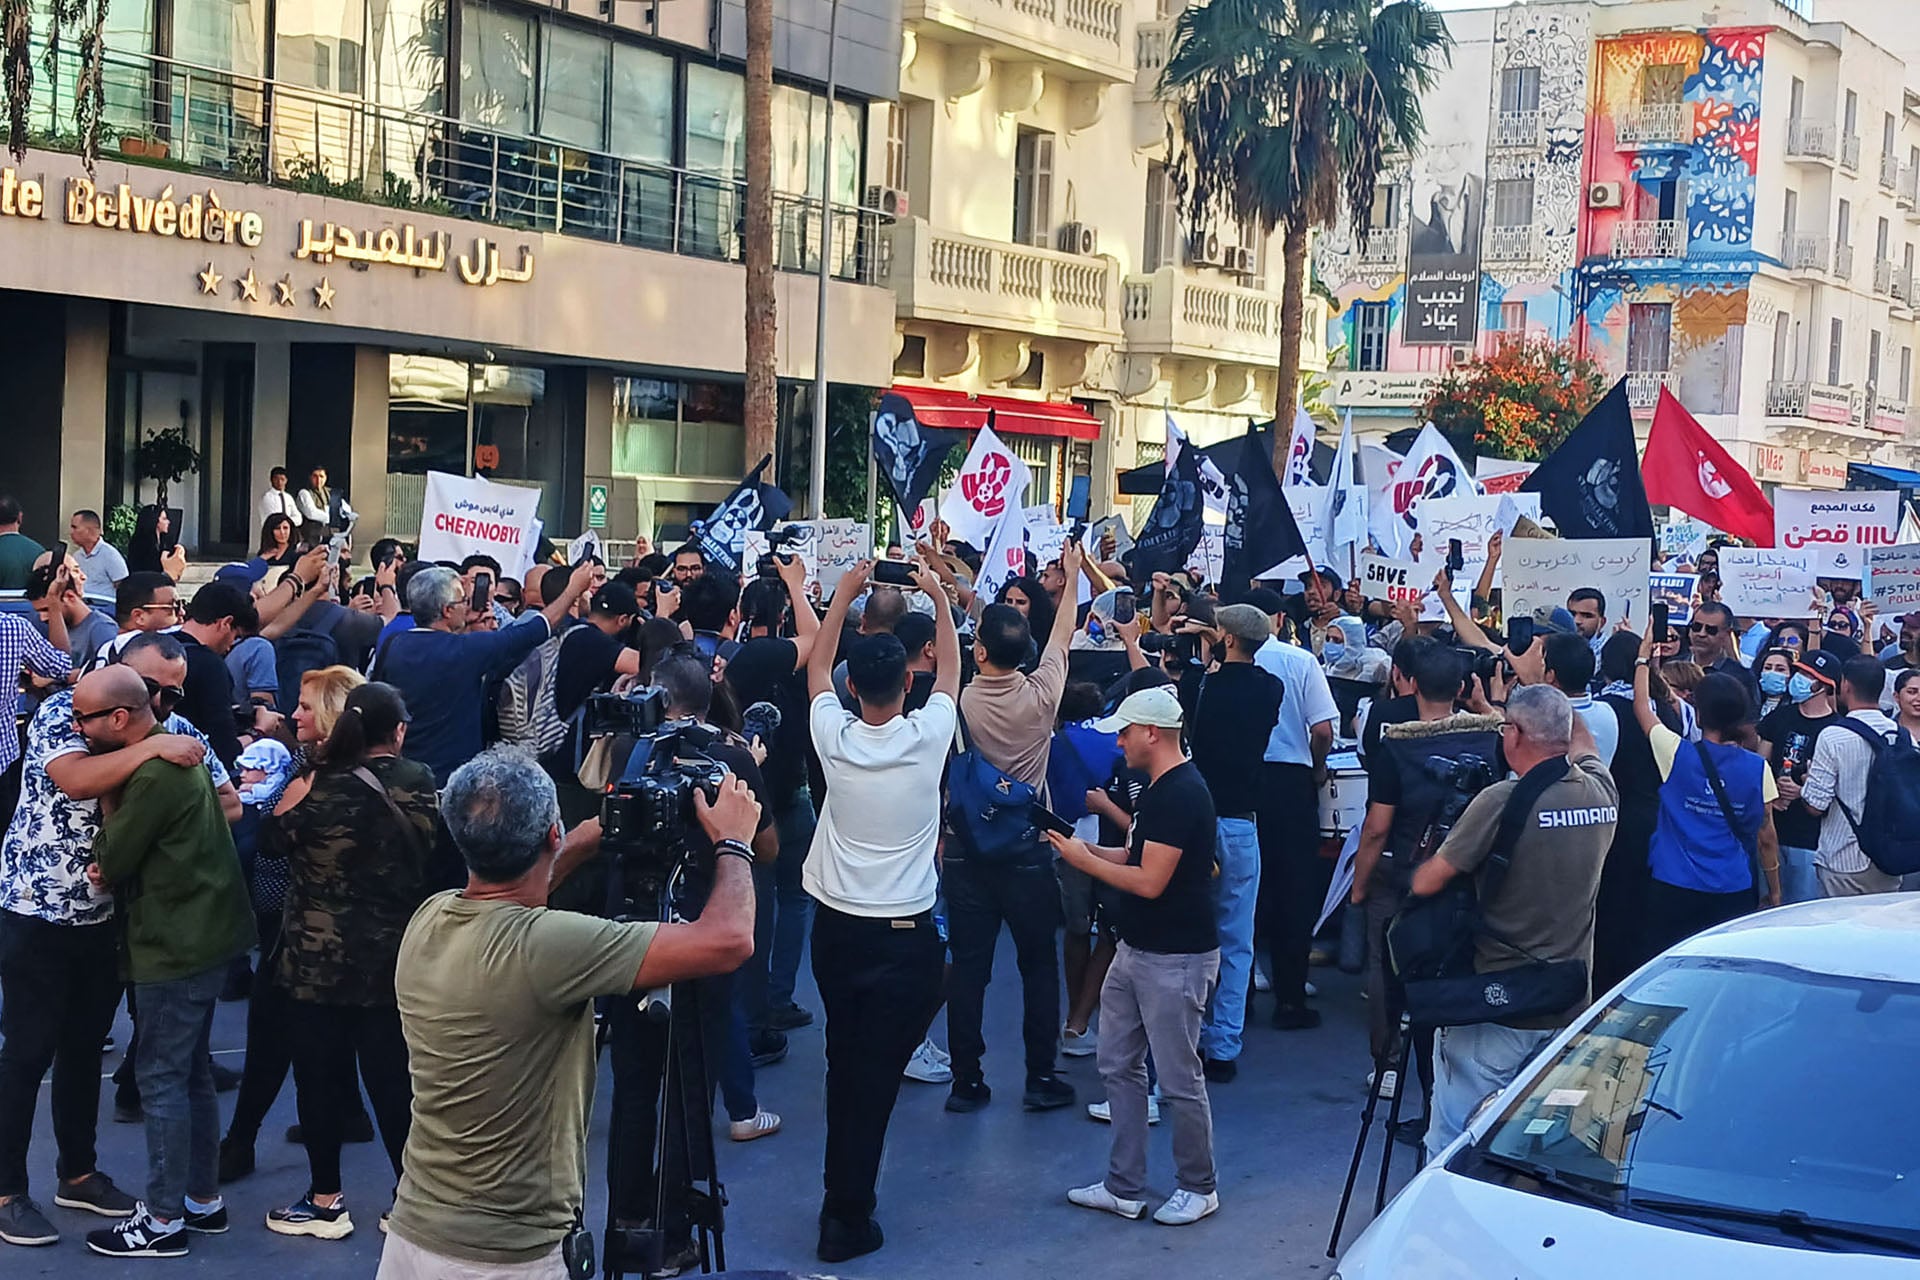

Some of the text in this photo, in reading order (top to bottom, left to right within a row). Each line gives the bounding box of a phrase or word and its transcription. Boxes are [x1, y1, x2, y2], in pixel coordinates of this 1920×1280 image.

[64, 177, 264, 247] Belvédère
[1410, 269, 1475, 285] لروحك السلام
[1417, 286, 1465, 308] نجيب
[1422, 308, 1458, 331] عياد
[1811, 503, 1876, 514] فكك المجمع
[435, 513, 521, 544] CHERNOBYL
[1367, 563, 1407, 585] SAVE
[1538, 806, 1618, 828] SHIMANO
[122, 1229, 148, 1249] N
